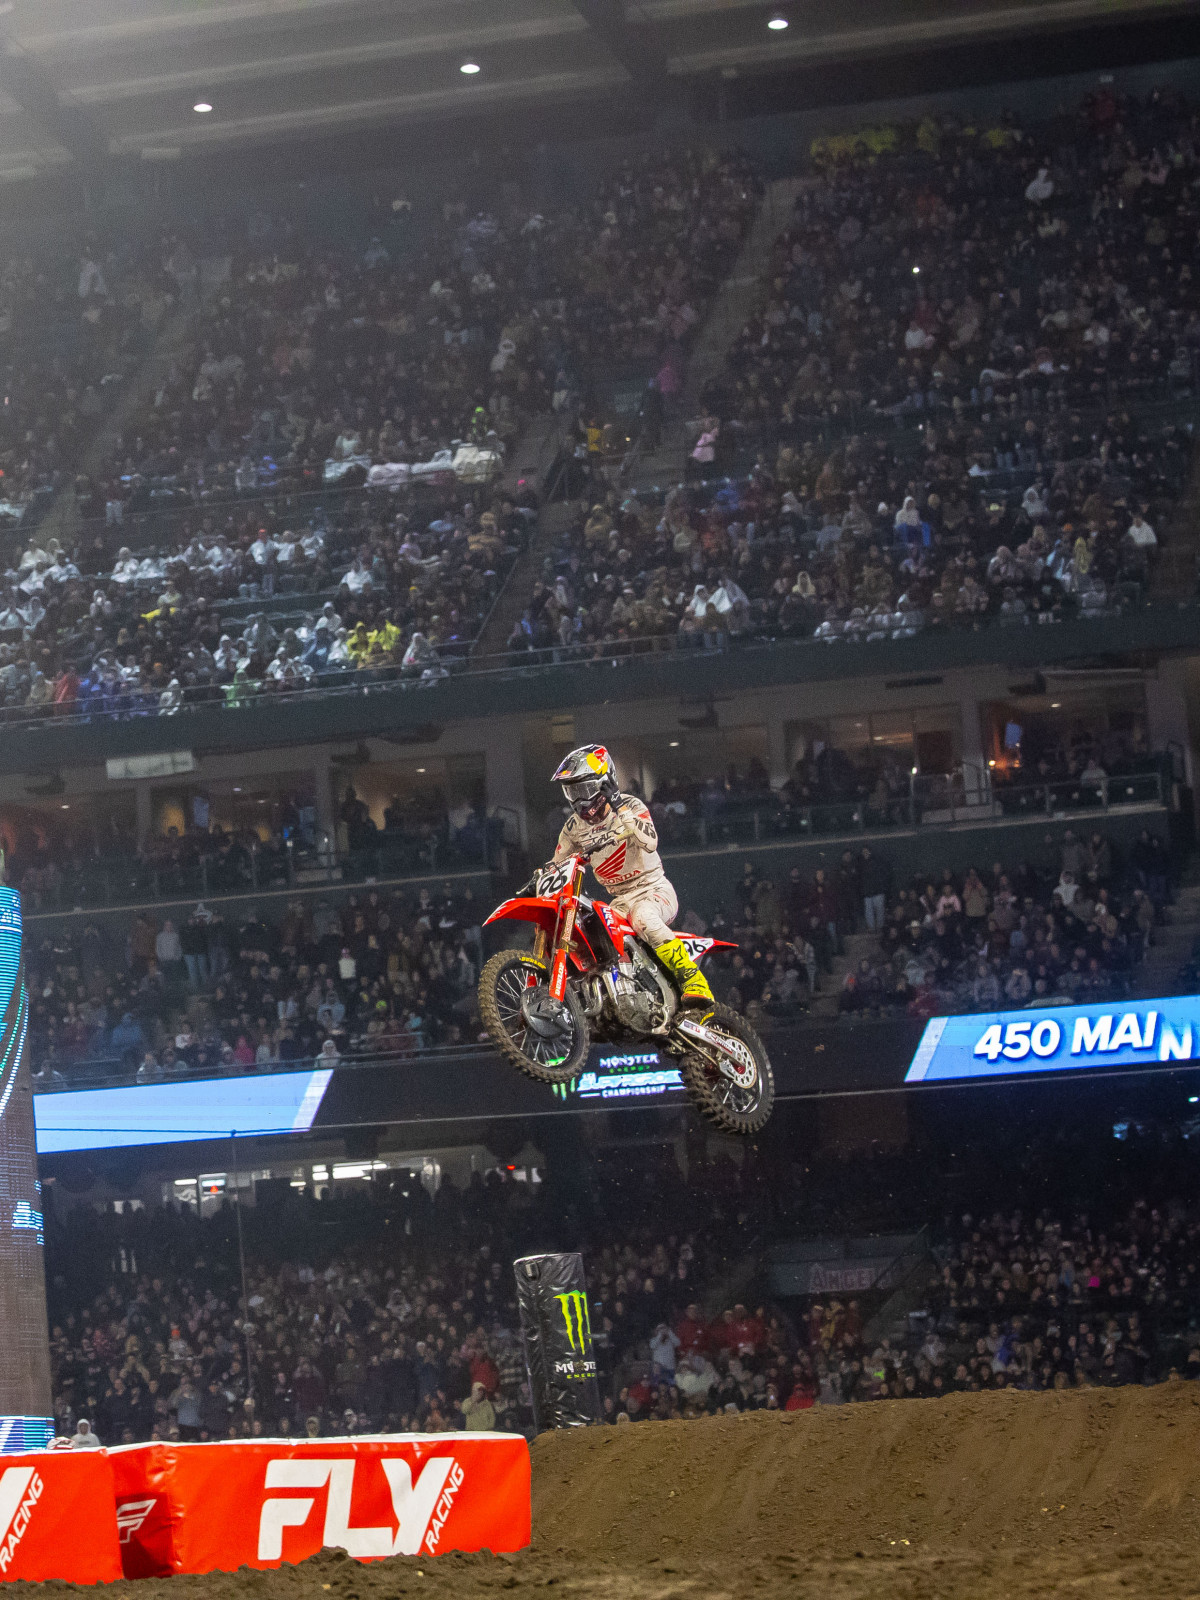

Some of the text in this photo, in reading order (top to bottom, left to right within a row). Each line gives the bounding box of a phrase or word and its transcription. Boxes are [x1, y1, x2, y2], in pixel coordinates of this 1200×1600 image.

[554, 962, 565, 997] DUNLOP
[974, 1011, 1193, 1061] 450 MAIN
[601, 1084, 666, 1098] CHAMPIONSHIP
[258, 1457, 455, 1561] FLY
[425, 1462, 465, 1554] RACING
